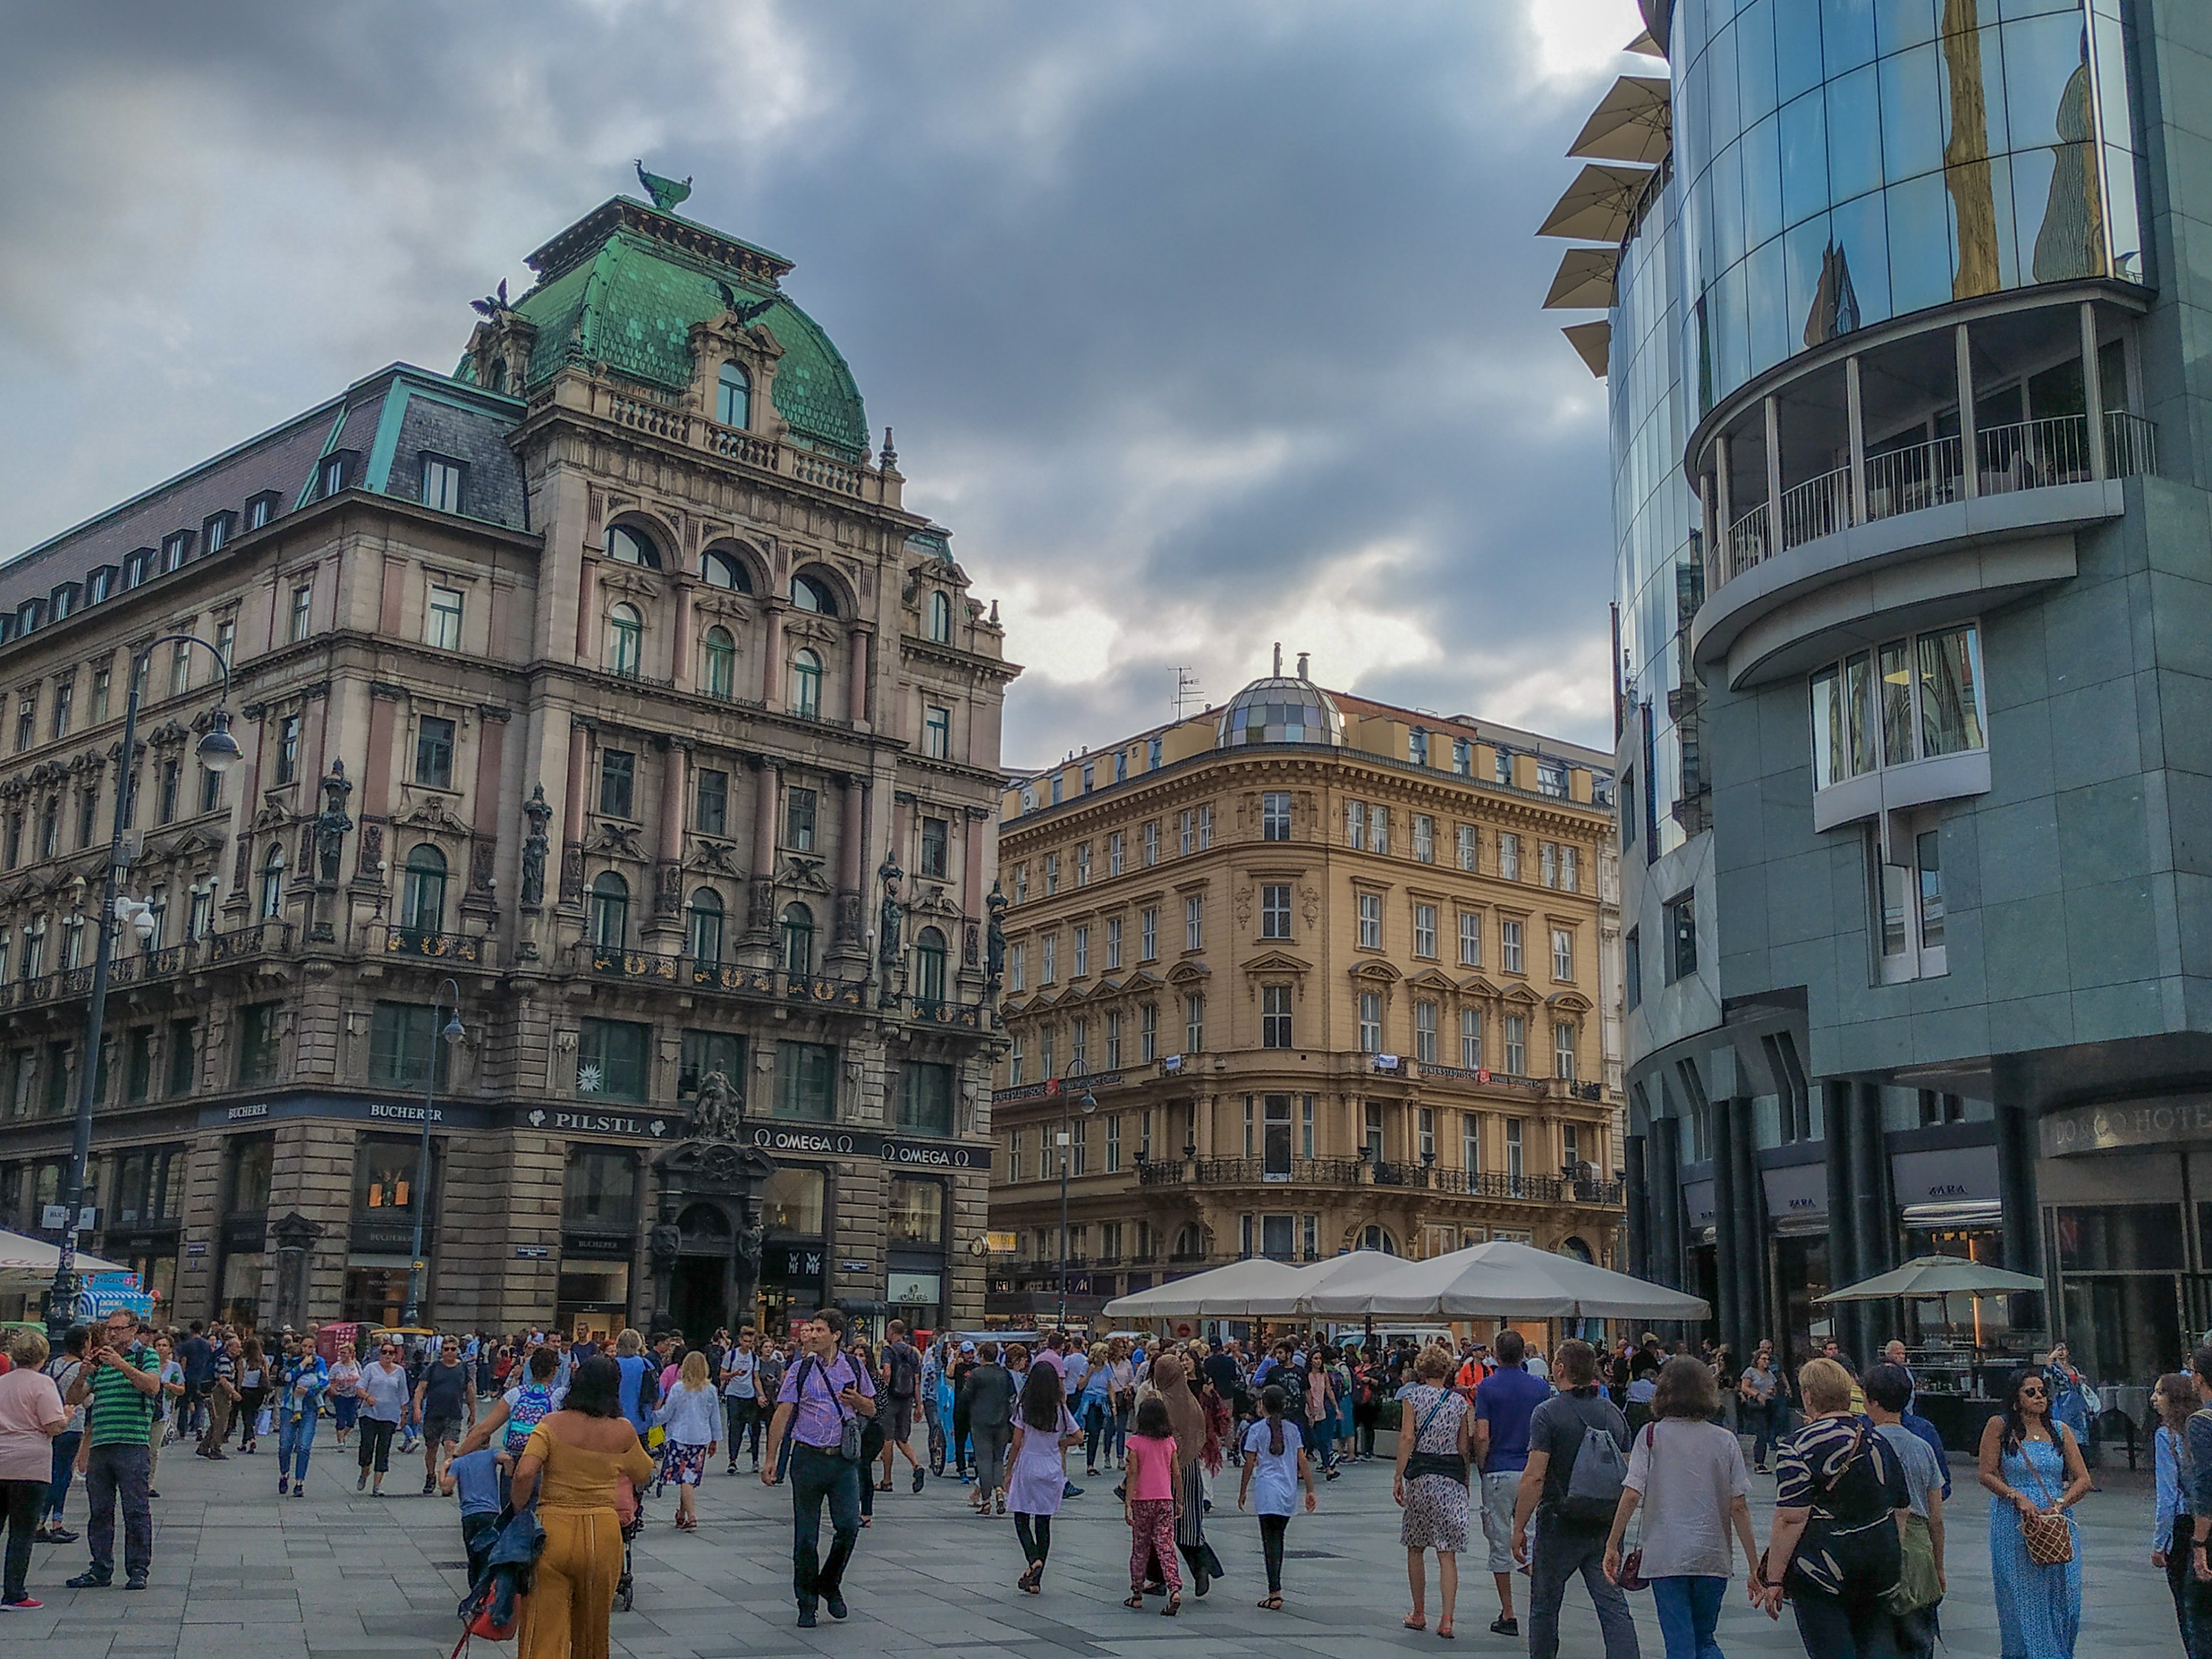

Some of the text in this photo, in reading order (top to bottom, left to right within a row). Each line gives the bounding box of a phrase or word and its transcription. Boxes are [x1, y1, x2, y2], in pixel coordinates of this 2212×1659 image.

[228, 1104, 267, 1119] BUCHERER
[370, 1105, 443, 1121] BUCHERER
[555, 1112, 641, 1133] PILSTL
[775, 1133, 832, 1151] OMEGA
[899, 1148, 950, 1165] OMEGA
[1928, 1185, 1968, 1195] ZARA
[1789, 1198, 1816, 1208] ZARA
[900, 1293, 929, 1301] OMEGA
